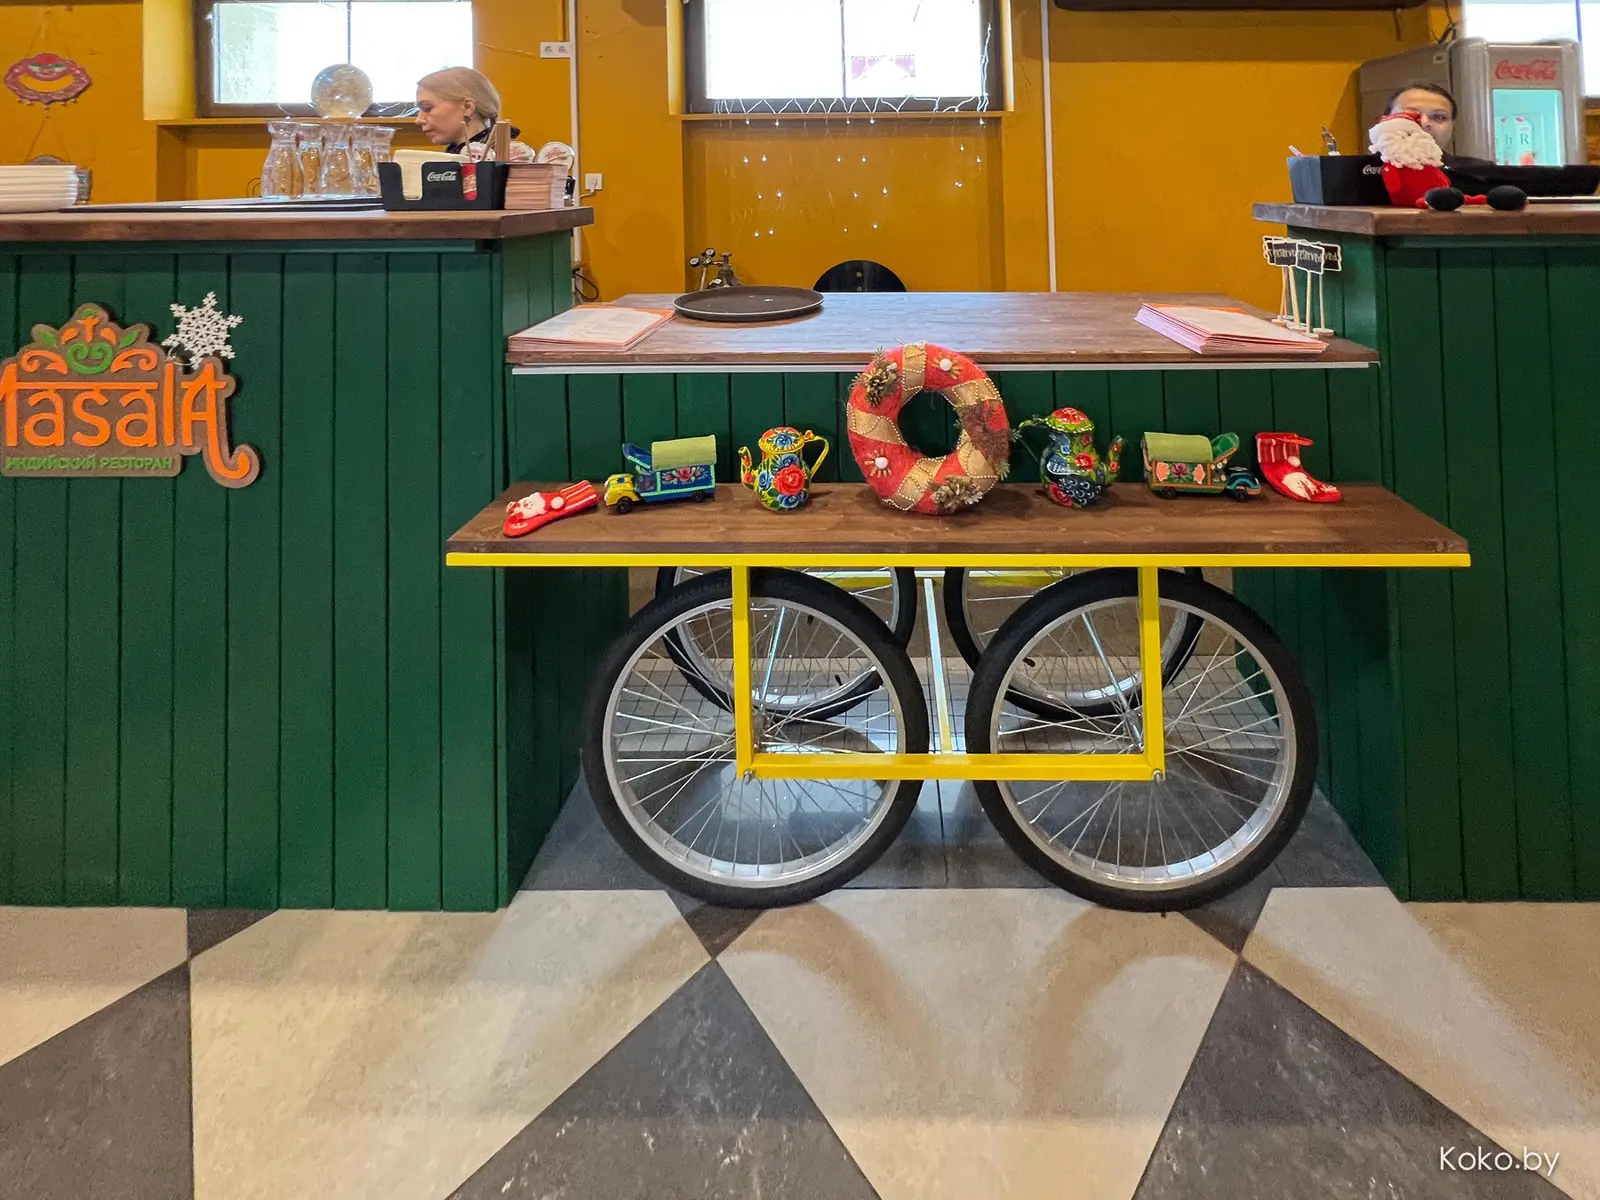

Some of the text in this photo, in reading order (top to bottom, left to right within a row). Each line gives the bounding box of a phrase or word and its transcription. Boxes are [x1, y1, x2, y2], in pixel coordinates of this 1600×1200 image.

[427, 171, 457, 182] Coca-Cola
[5, 455, 173, 470] ИНДИЙСКИЙ РЕСТОРАН
